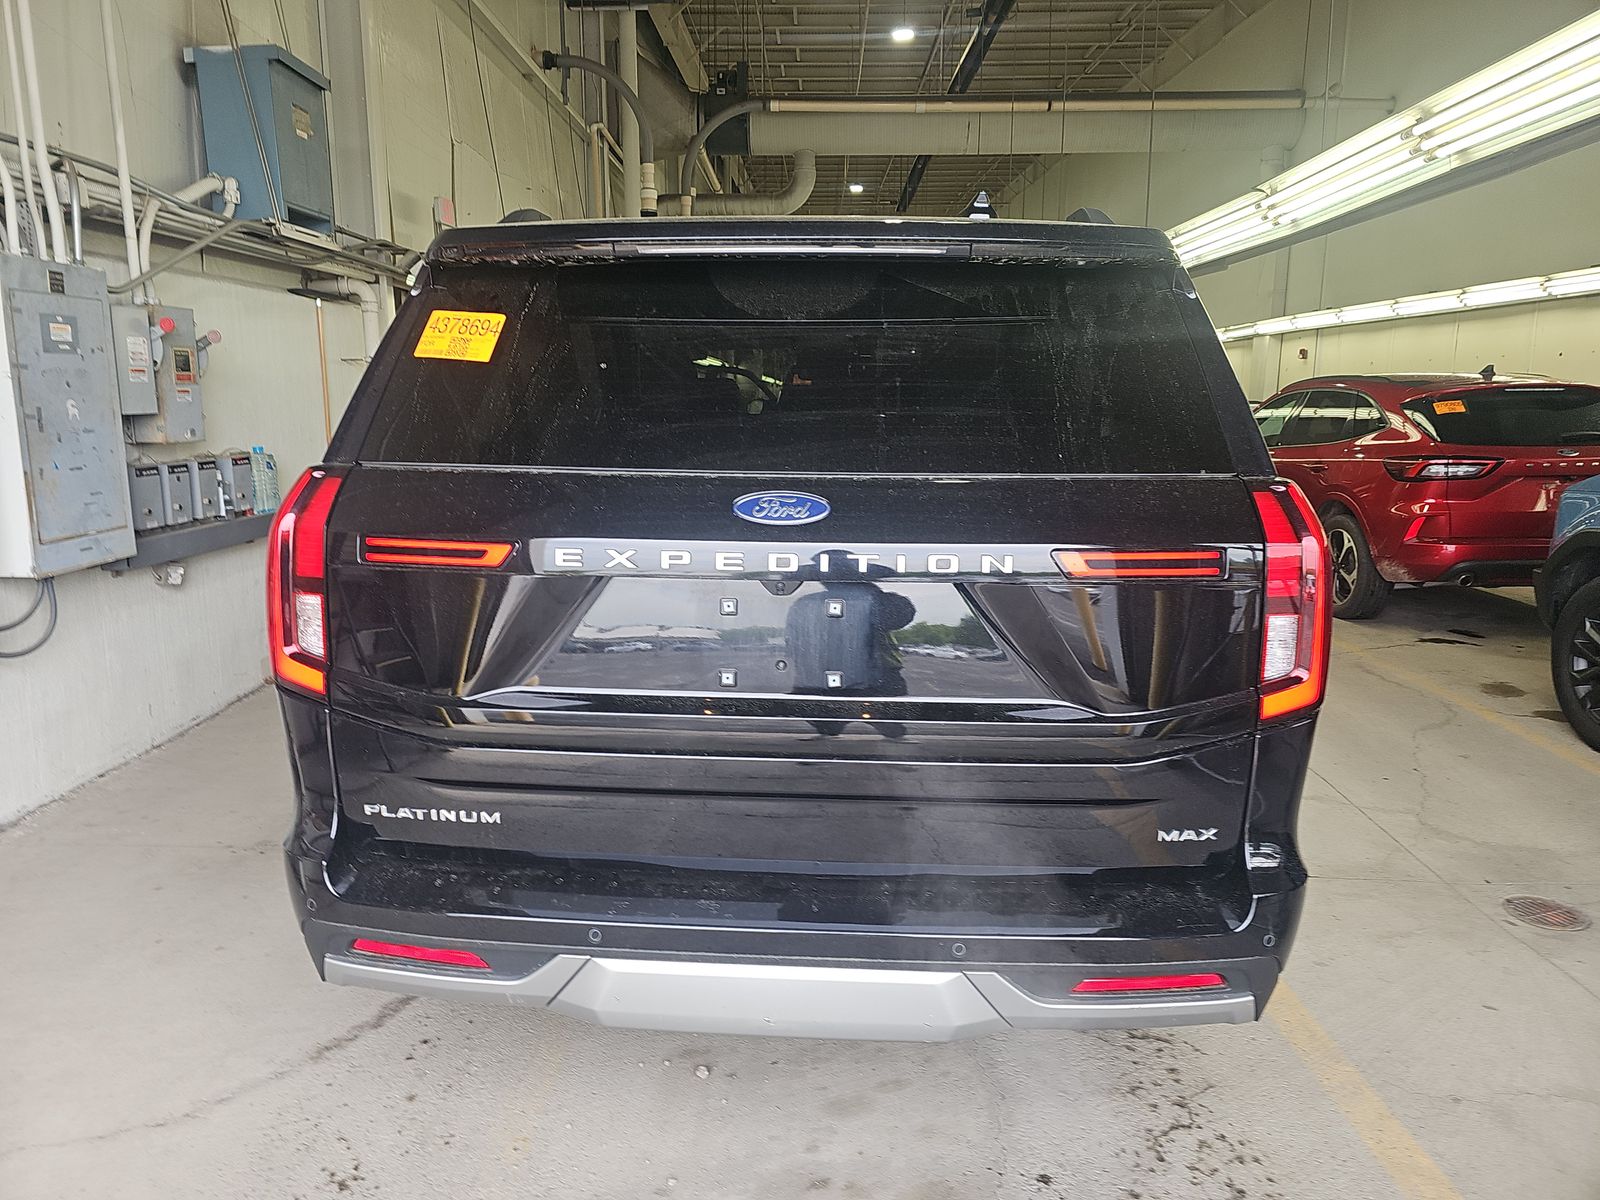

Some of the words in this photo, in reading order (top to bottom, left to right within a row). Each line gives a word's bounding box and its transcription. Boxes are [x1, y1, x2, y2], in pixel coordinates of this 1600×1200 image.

[430, 316, 501, 337] 4378694
[752, 497, 812, 519] Ford
[553, 547, 1015, 575] EXPEDITION
[363, 803, 502, 825] PLATINUM
[1157, 827, 1221, 842] MAX
